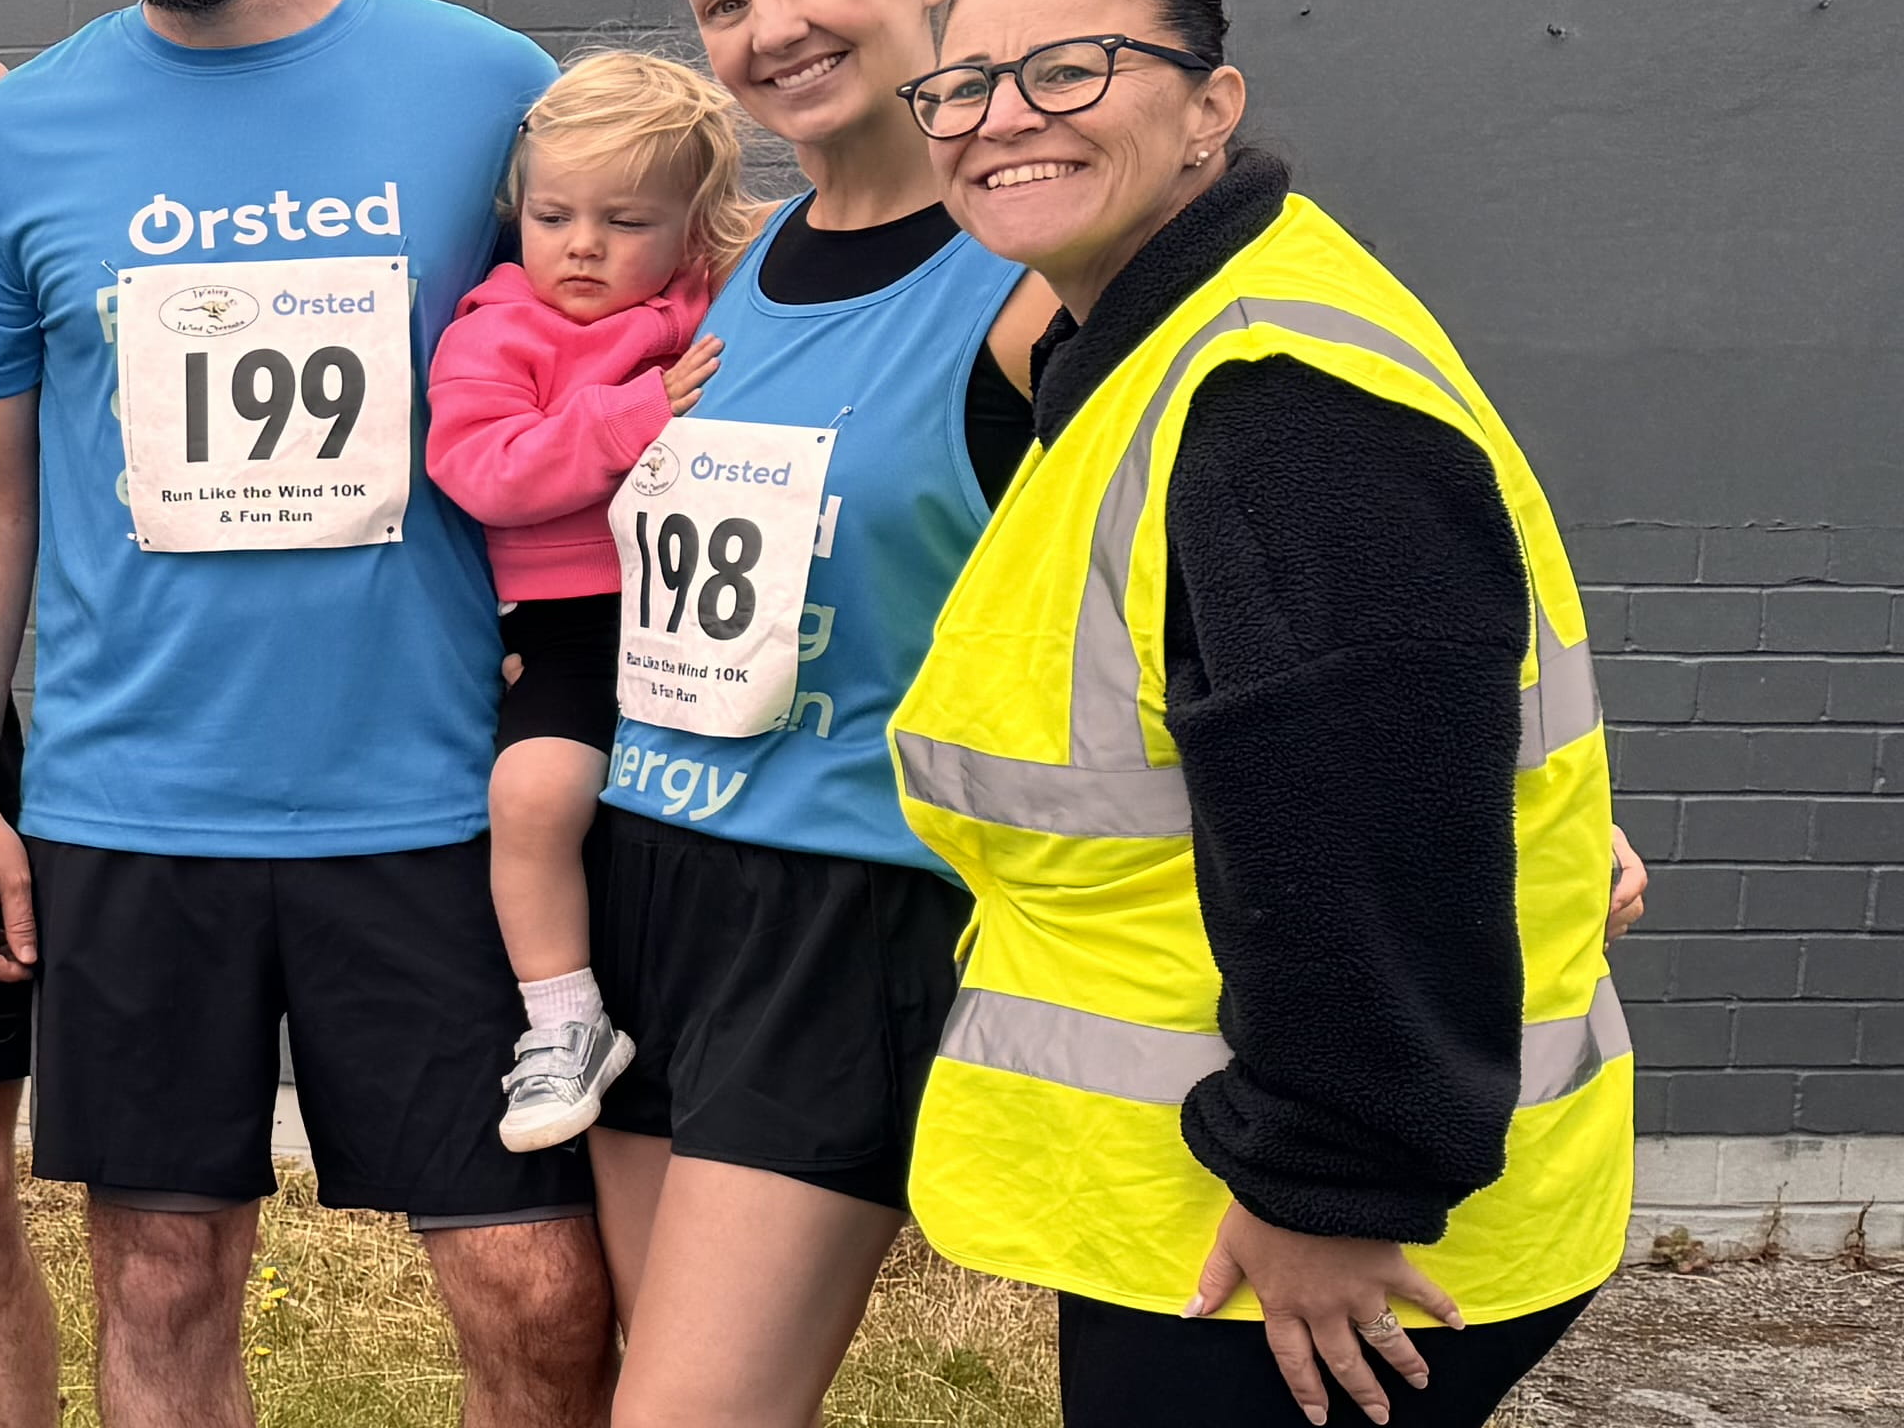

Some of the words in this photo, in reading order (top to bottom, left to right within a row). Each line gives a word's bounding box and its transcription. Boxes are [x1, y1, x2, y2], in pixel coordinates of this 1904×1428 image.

[128, 181, 402, 255] Ørsted
[272, 289, 375, 316] Ørsted
[185, 346, 366, 463] 199
[691, 451, 792, 486] Ørsted
[162, 490, 193, 502] Run
[199, 487, 236, 500] Like
[243, 486, 272, 499] the
[278, 484, 323, 498] Wind
[330, 484, 367, 497] 10K
[220, 511, 233, 523] &
[240, 510, 271, 523] Fun
[278, 509, 313, 522] Run
[636, 512, 762, 641] 198
[715, 667, 749, 683] 10K
[609, 740, 748, 822] nergy
